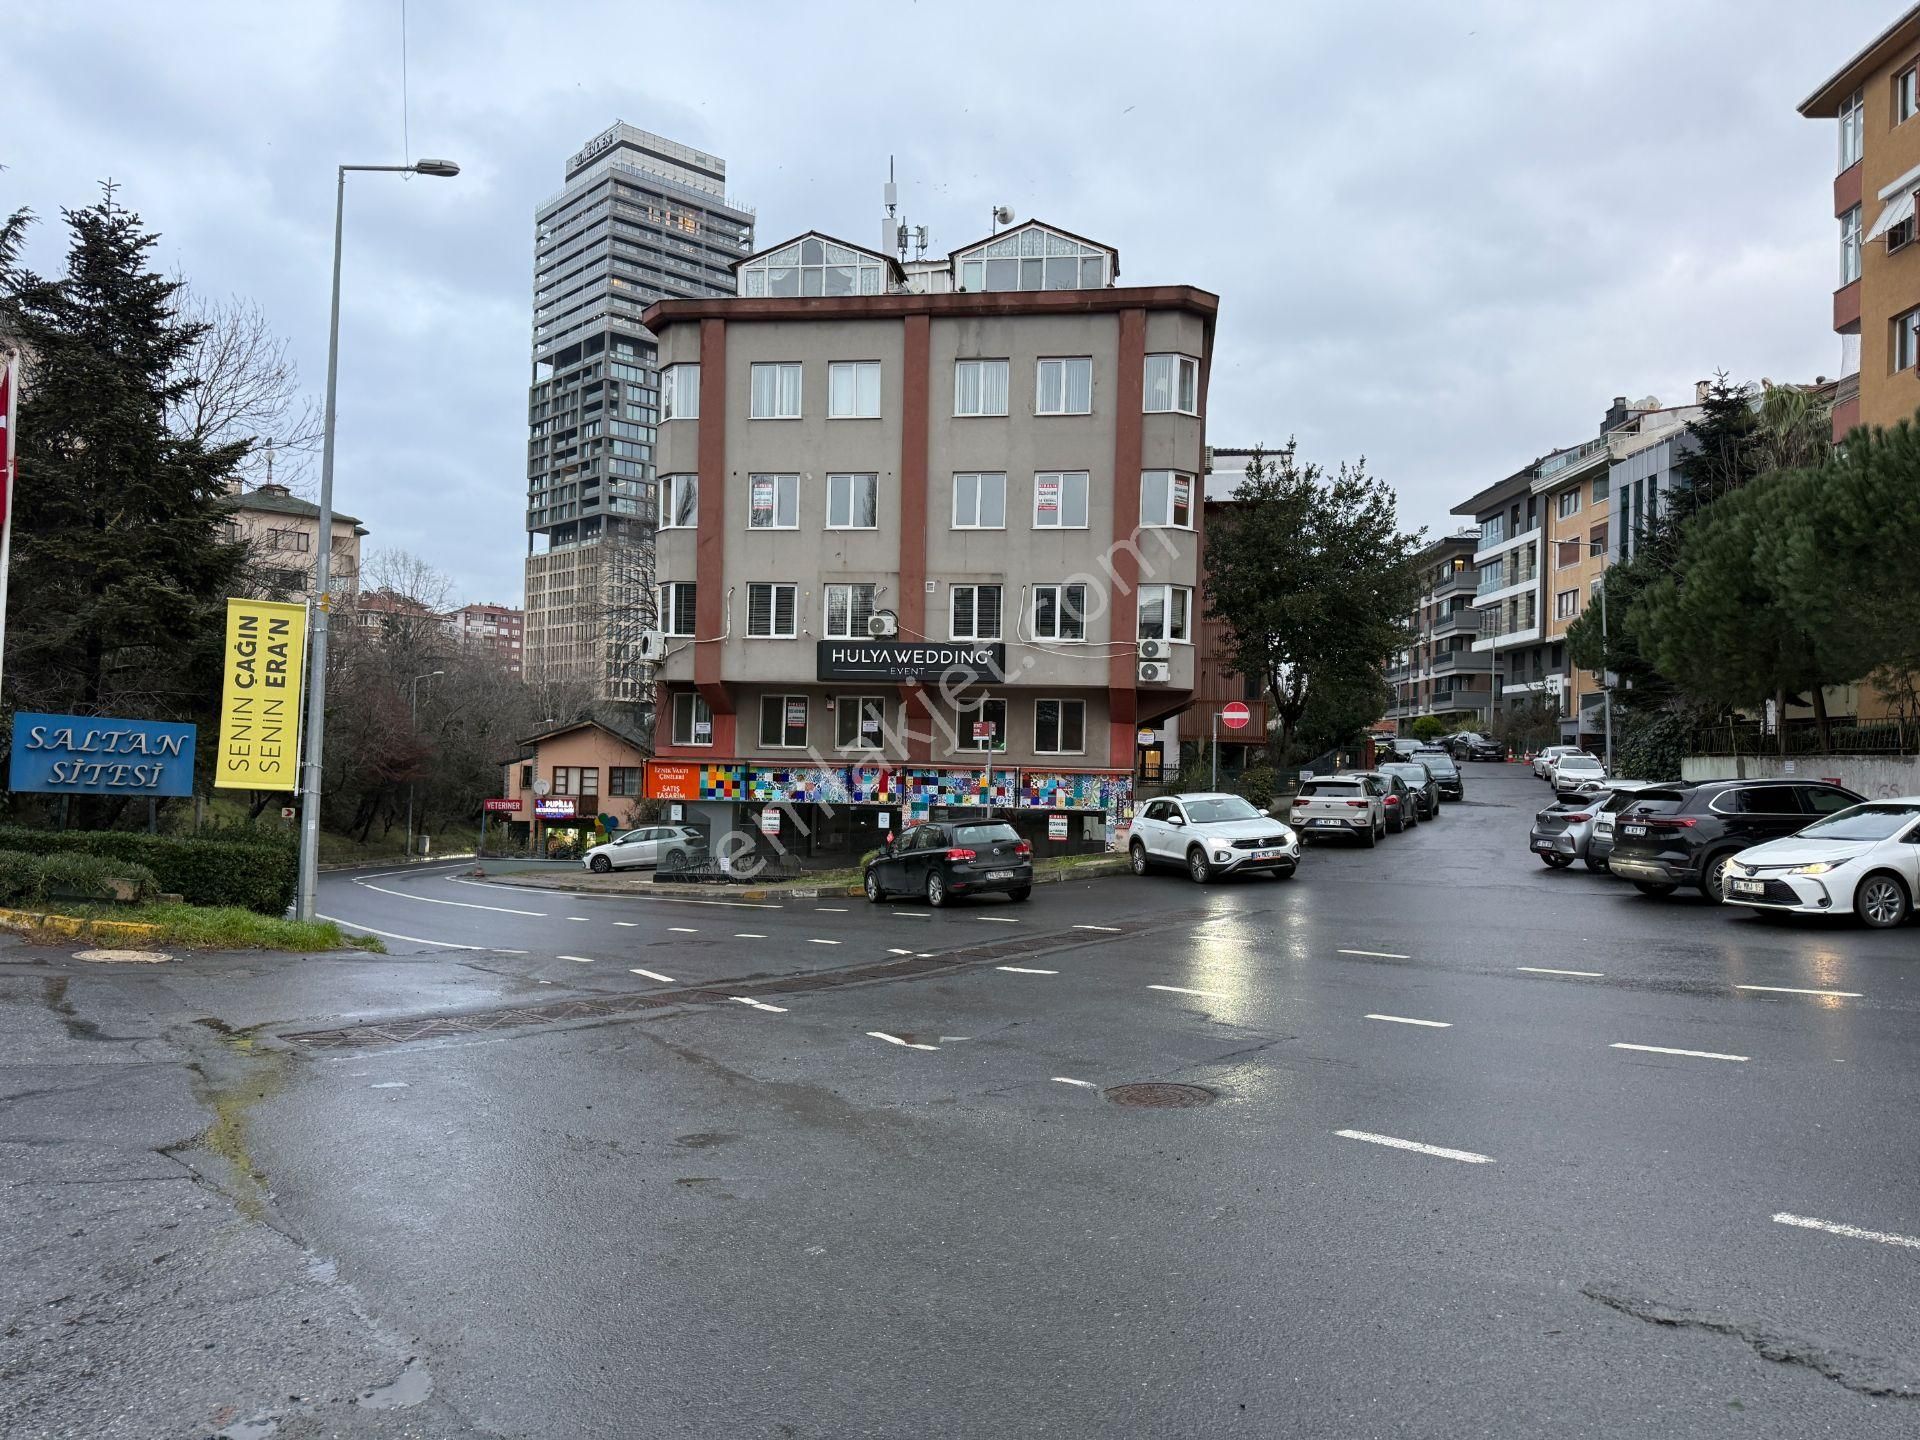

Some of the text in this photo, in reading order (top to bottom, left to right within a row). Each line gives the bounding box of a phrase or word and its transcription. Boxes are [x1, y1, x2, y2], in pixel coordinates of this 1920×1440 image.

[890, 667, 925, 675] EVENT
[228, 615, 259, 772] SENİN ÇAĞIN
[25, 726, 189, 757] SALTAN
[259, 699, 284, 773] SENİN
[48, 758, 164, 788] SİTESİ
